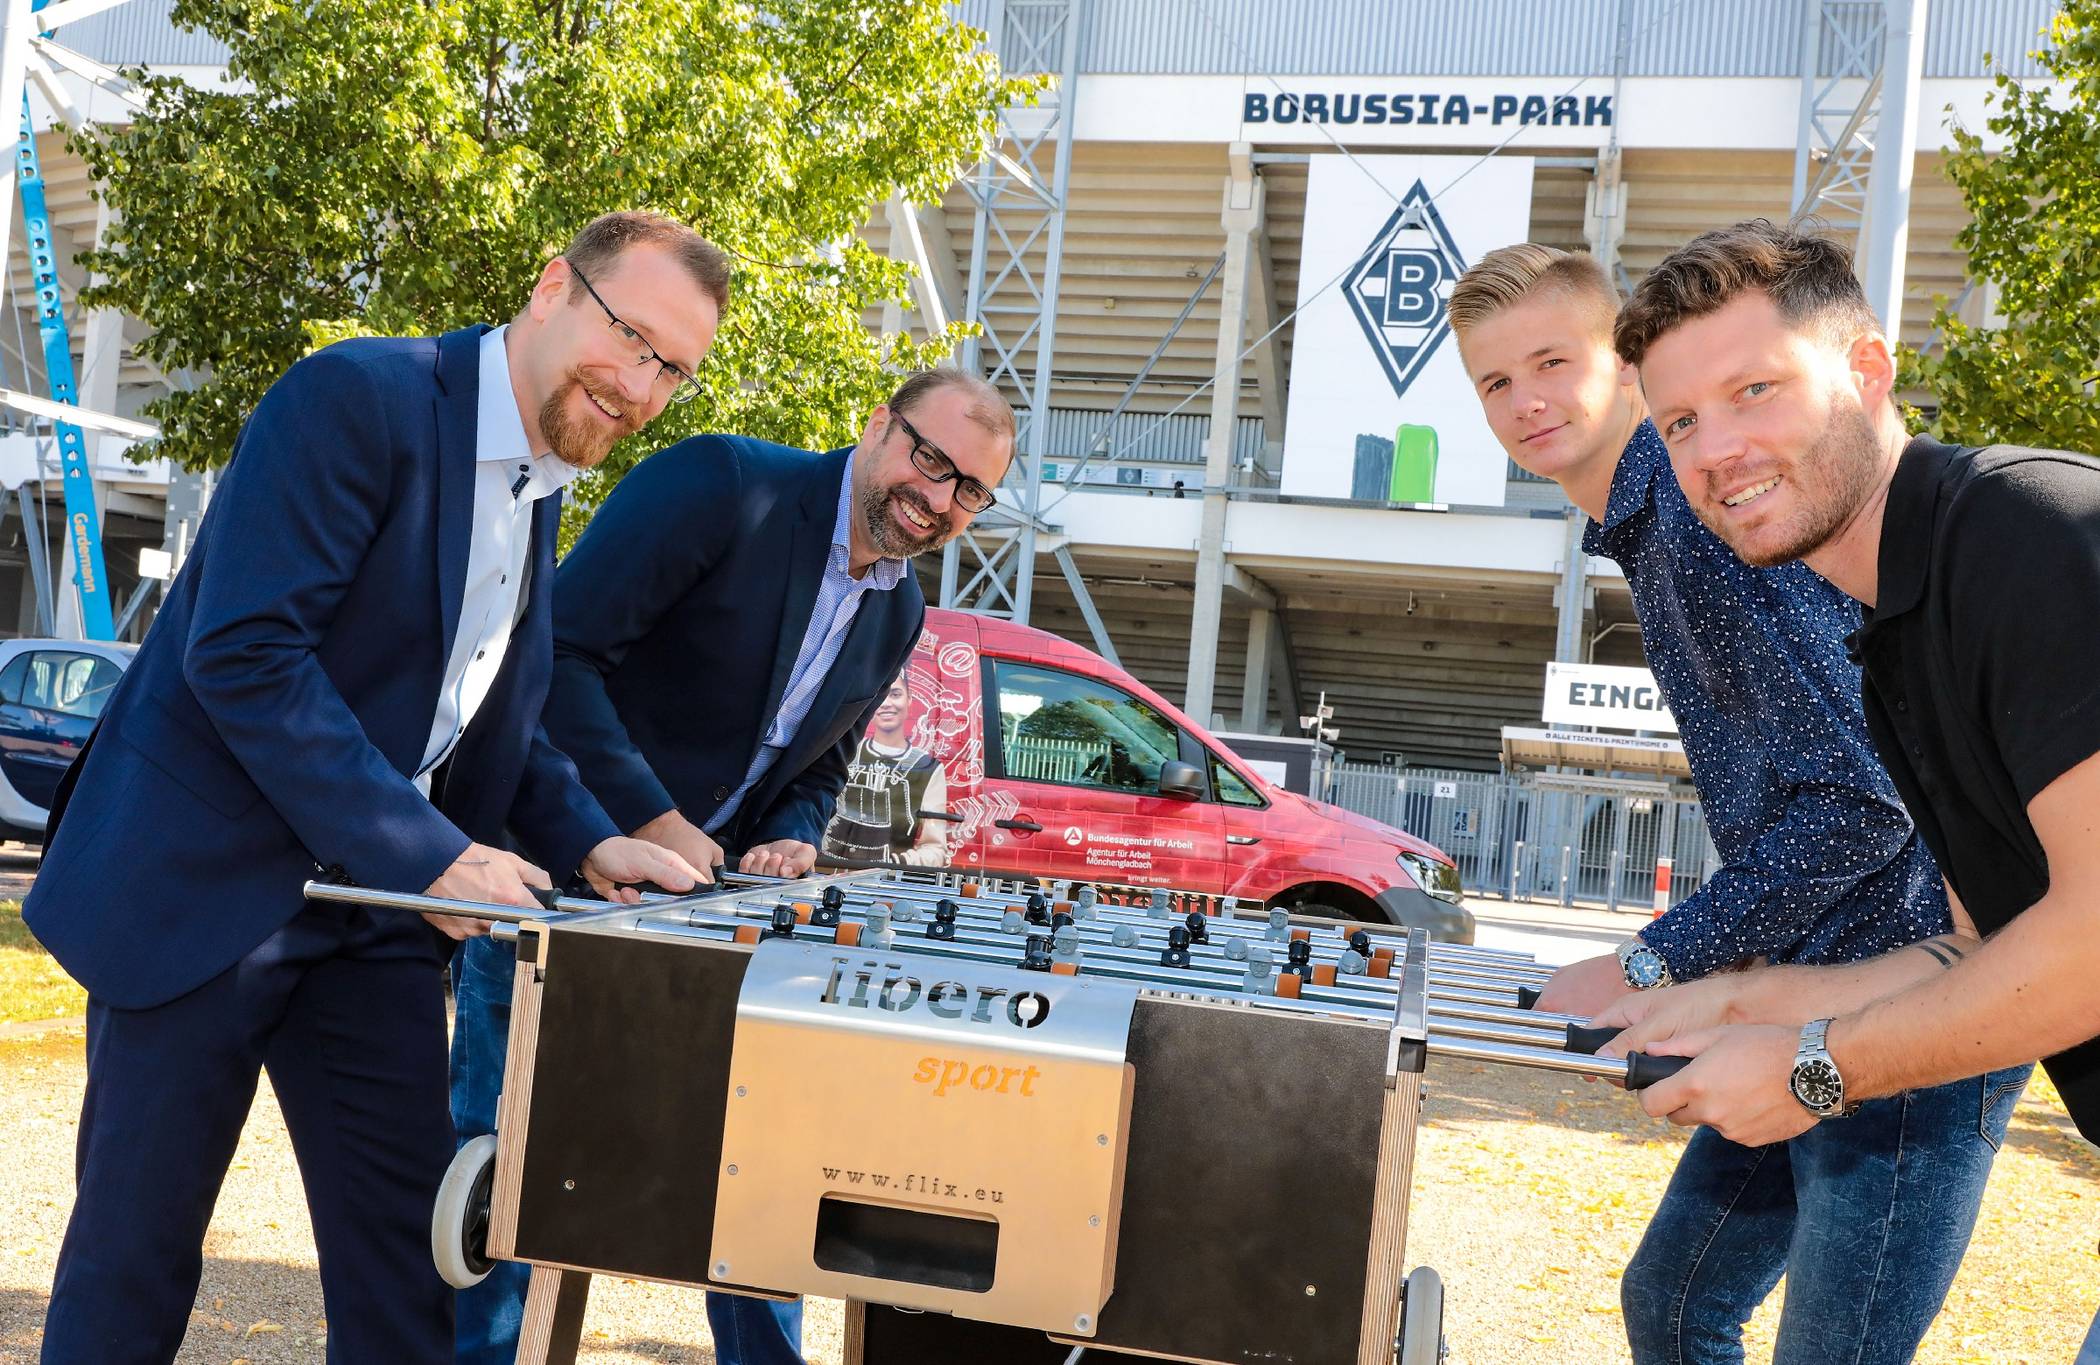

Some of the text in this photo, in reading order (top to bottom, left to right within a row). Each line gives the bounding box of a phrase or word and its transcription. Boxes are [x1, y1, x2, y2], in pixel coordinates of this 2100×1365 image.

[1243, 92, 1613, 127] BORUSSIA-PARK
[73, 512, 96, 593] Gardemann
[1552, 733, 1570, 741] ALLE
[1572, 735, 1604, 744] TICKETS
[1086, 847, 1152, 859] Agentur für Arbeit
[1087, 833, 1193, 849] Bundesagentur für Arbeit
[1086, 856, 1152, 869] Mönchengladbach
[1127, 874, 1172, 884] bringt weiter.
[820, 957, 1051, 1028] libero
[912, 1056, 1041, 1097] sport
[822, 1167, 1004, 1204] www.flix.eu
